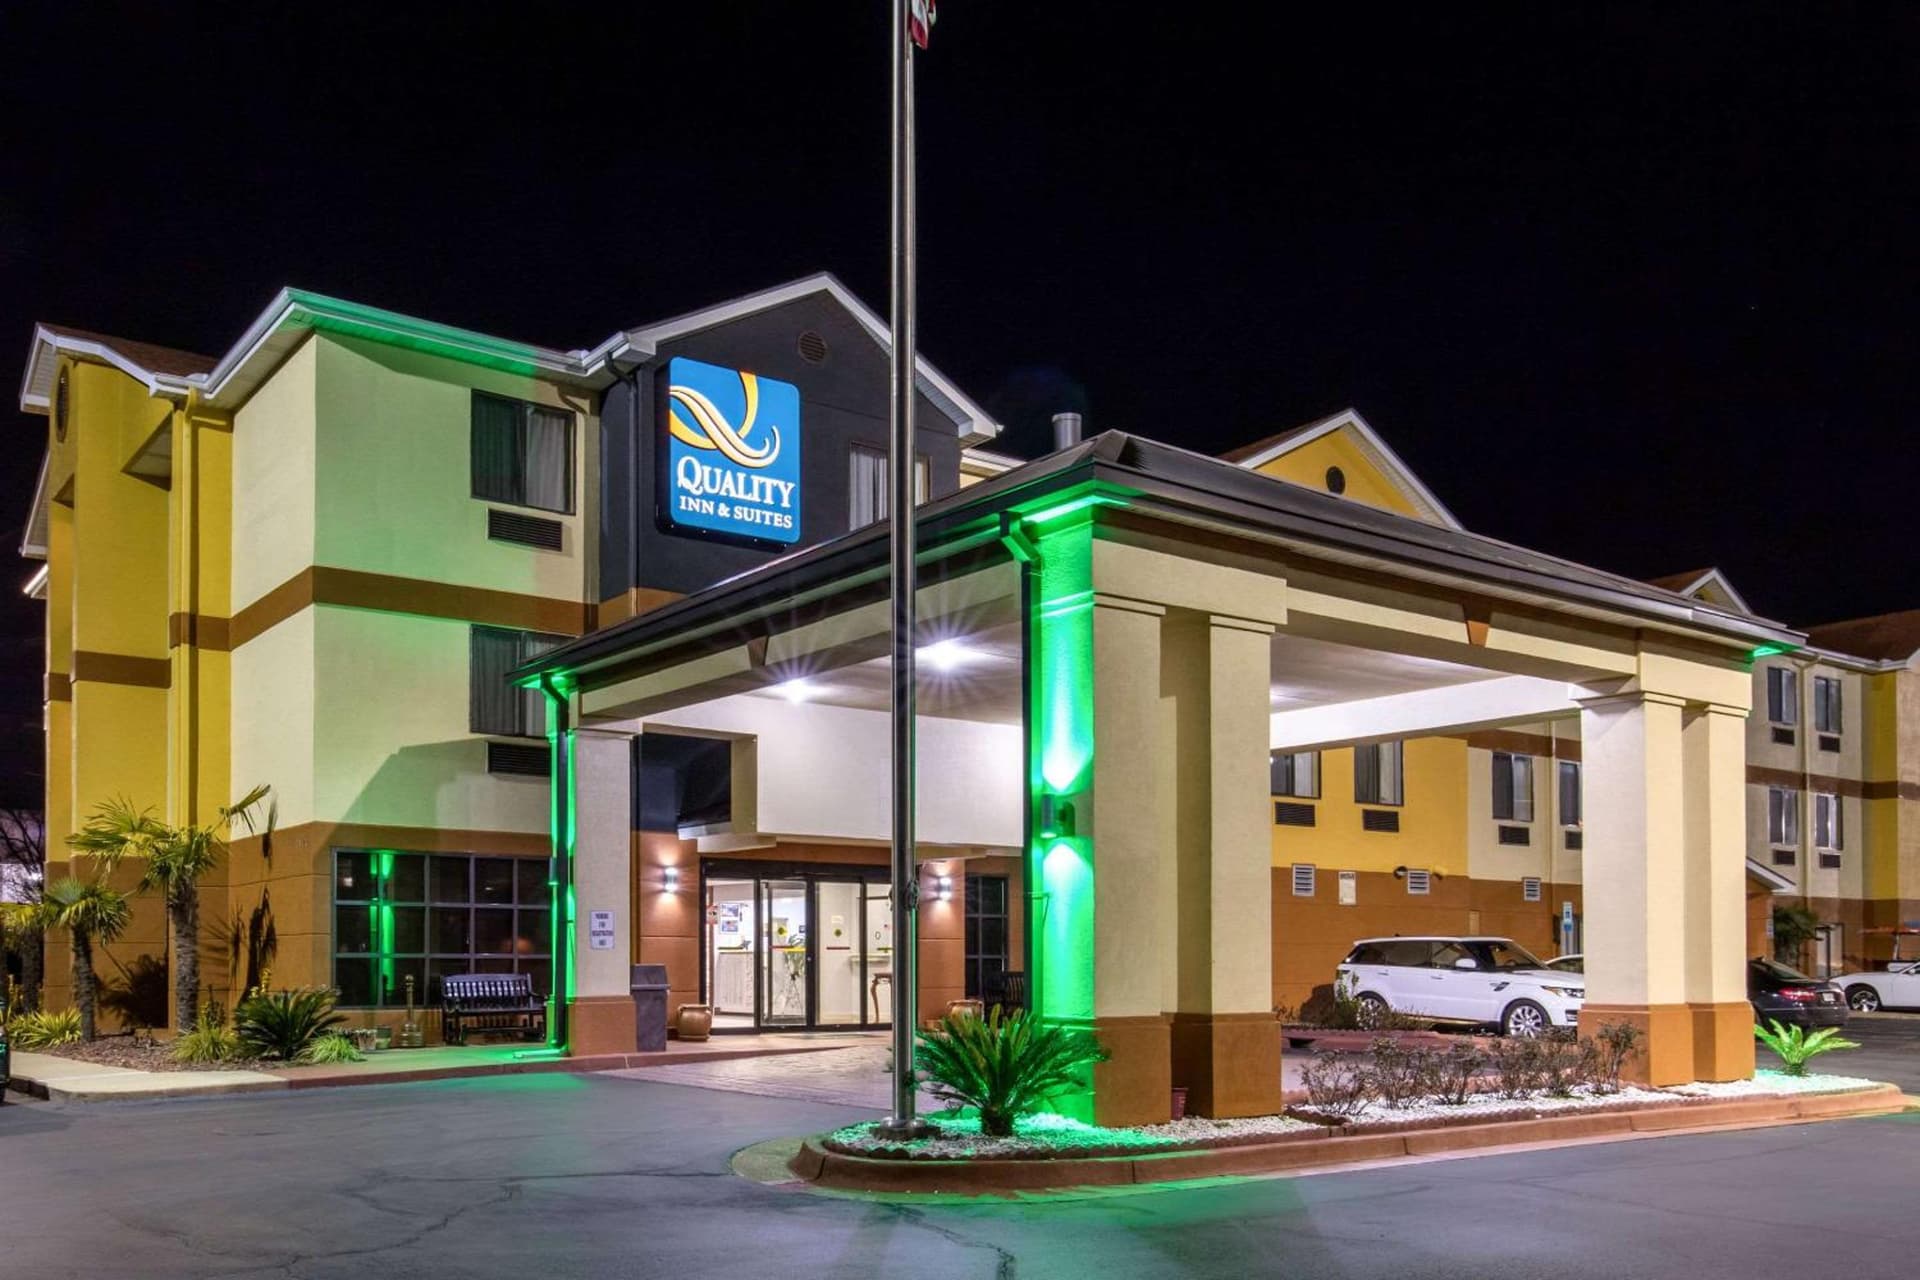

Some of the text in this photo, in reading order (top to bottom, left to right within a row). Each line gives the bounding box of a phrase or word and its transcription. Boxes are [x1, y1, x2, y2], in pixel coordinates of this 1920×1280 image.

[676, 455, 796, 508] QUALITY
[679, 495, 793, 529] INN & SUITES
